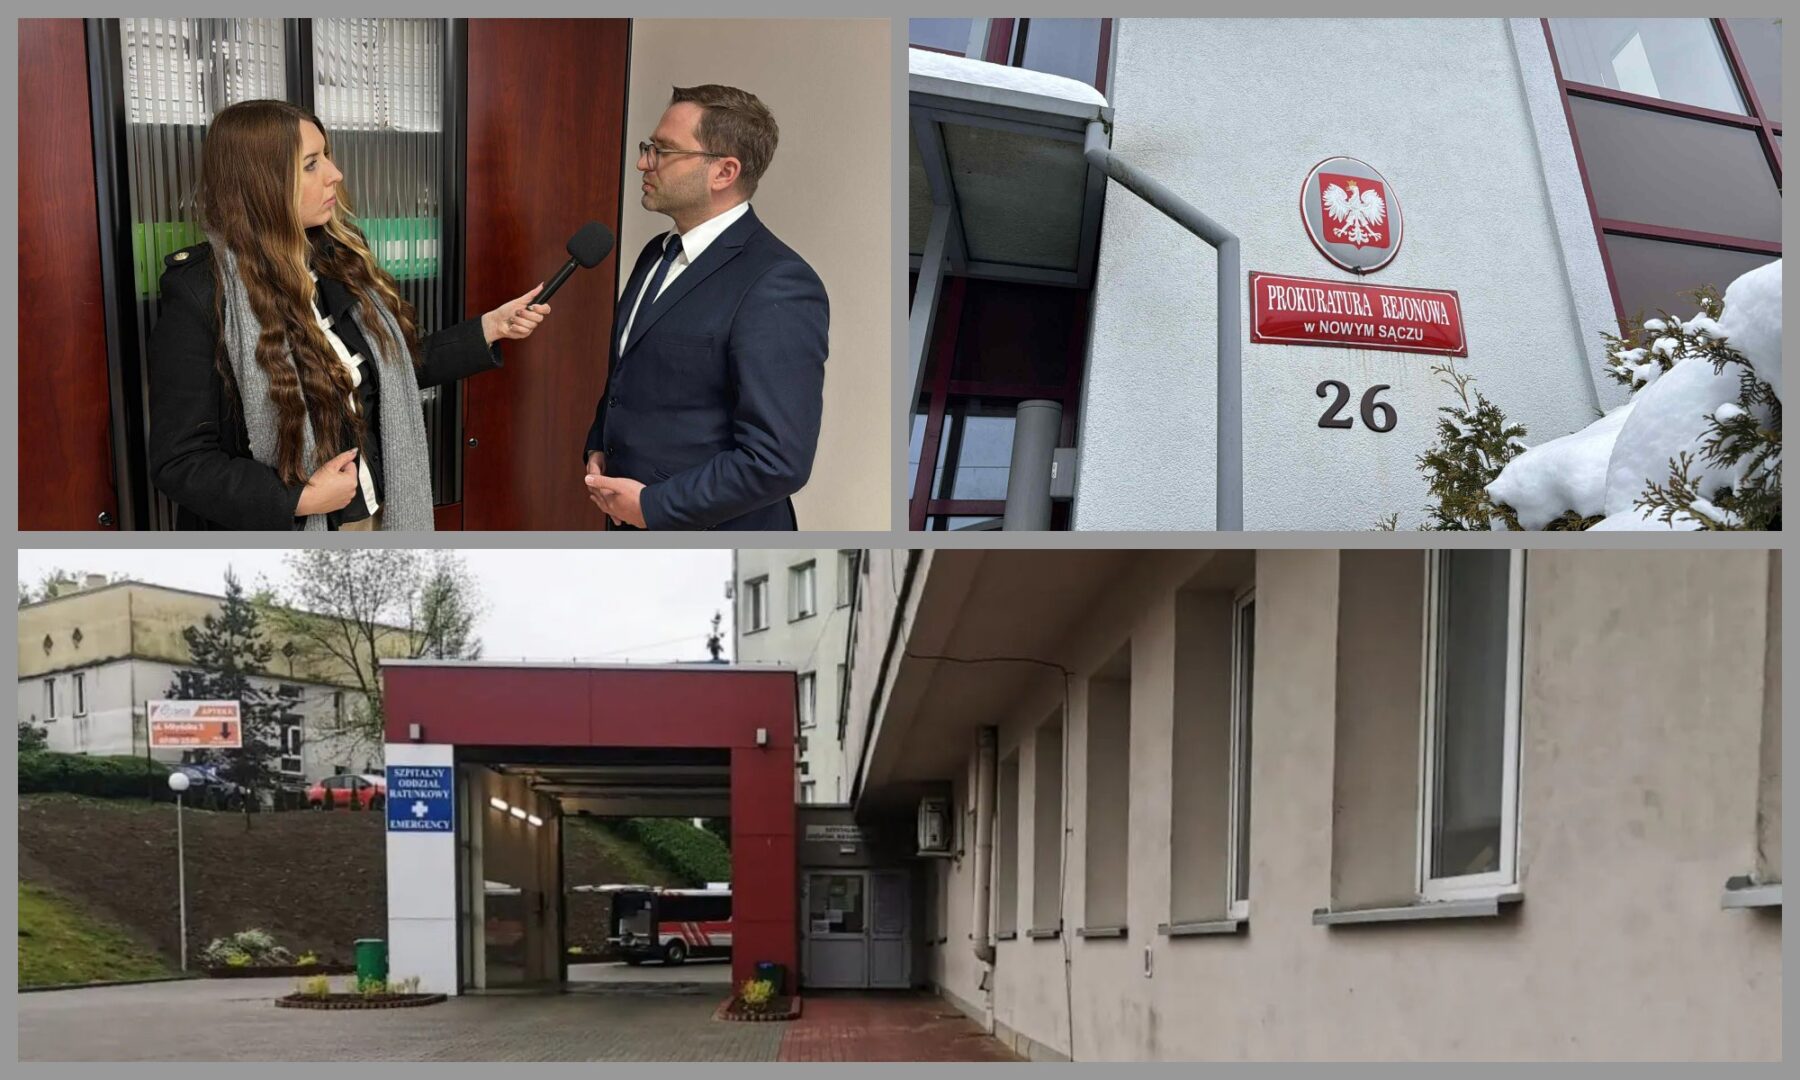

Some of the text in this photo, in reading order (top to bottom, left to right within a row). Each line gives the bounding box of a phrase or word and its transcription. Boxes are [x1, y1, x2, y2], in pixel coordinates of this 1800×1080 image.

[1267, 284, 1450, 326] PROKURATURA REJONOWA
[1304, 320, 1424, 342] w NOWYM SĄCZU
[1315, 379, 1398, 433] 26
[393, 768, 446, 778] SZPITALNY
[388, 789, 450, 799] RATUNKOWY
[389, 819, 450, 829] EMERGENCY
